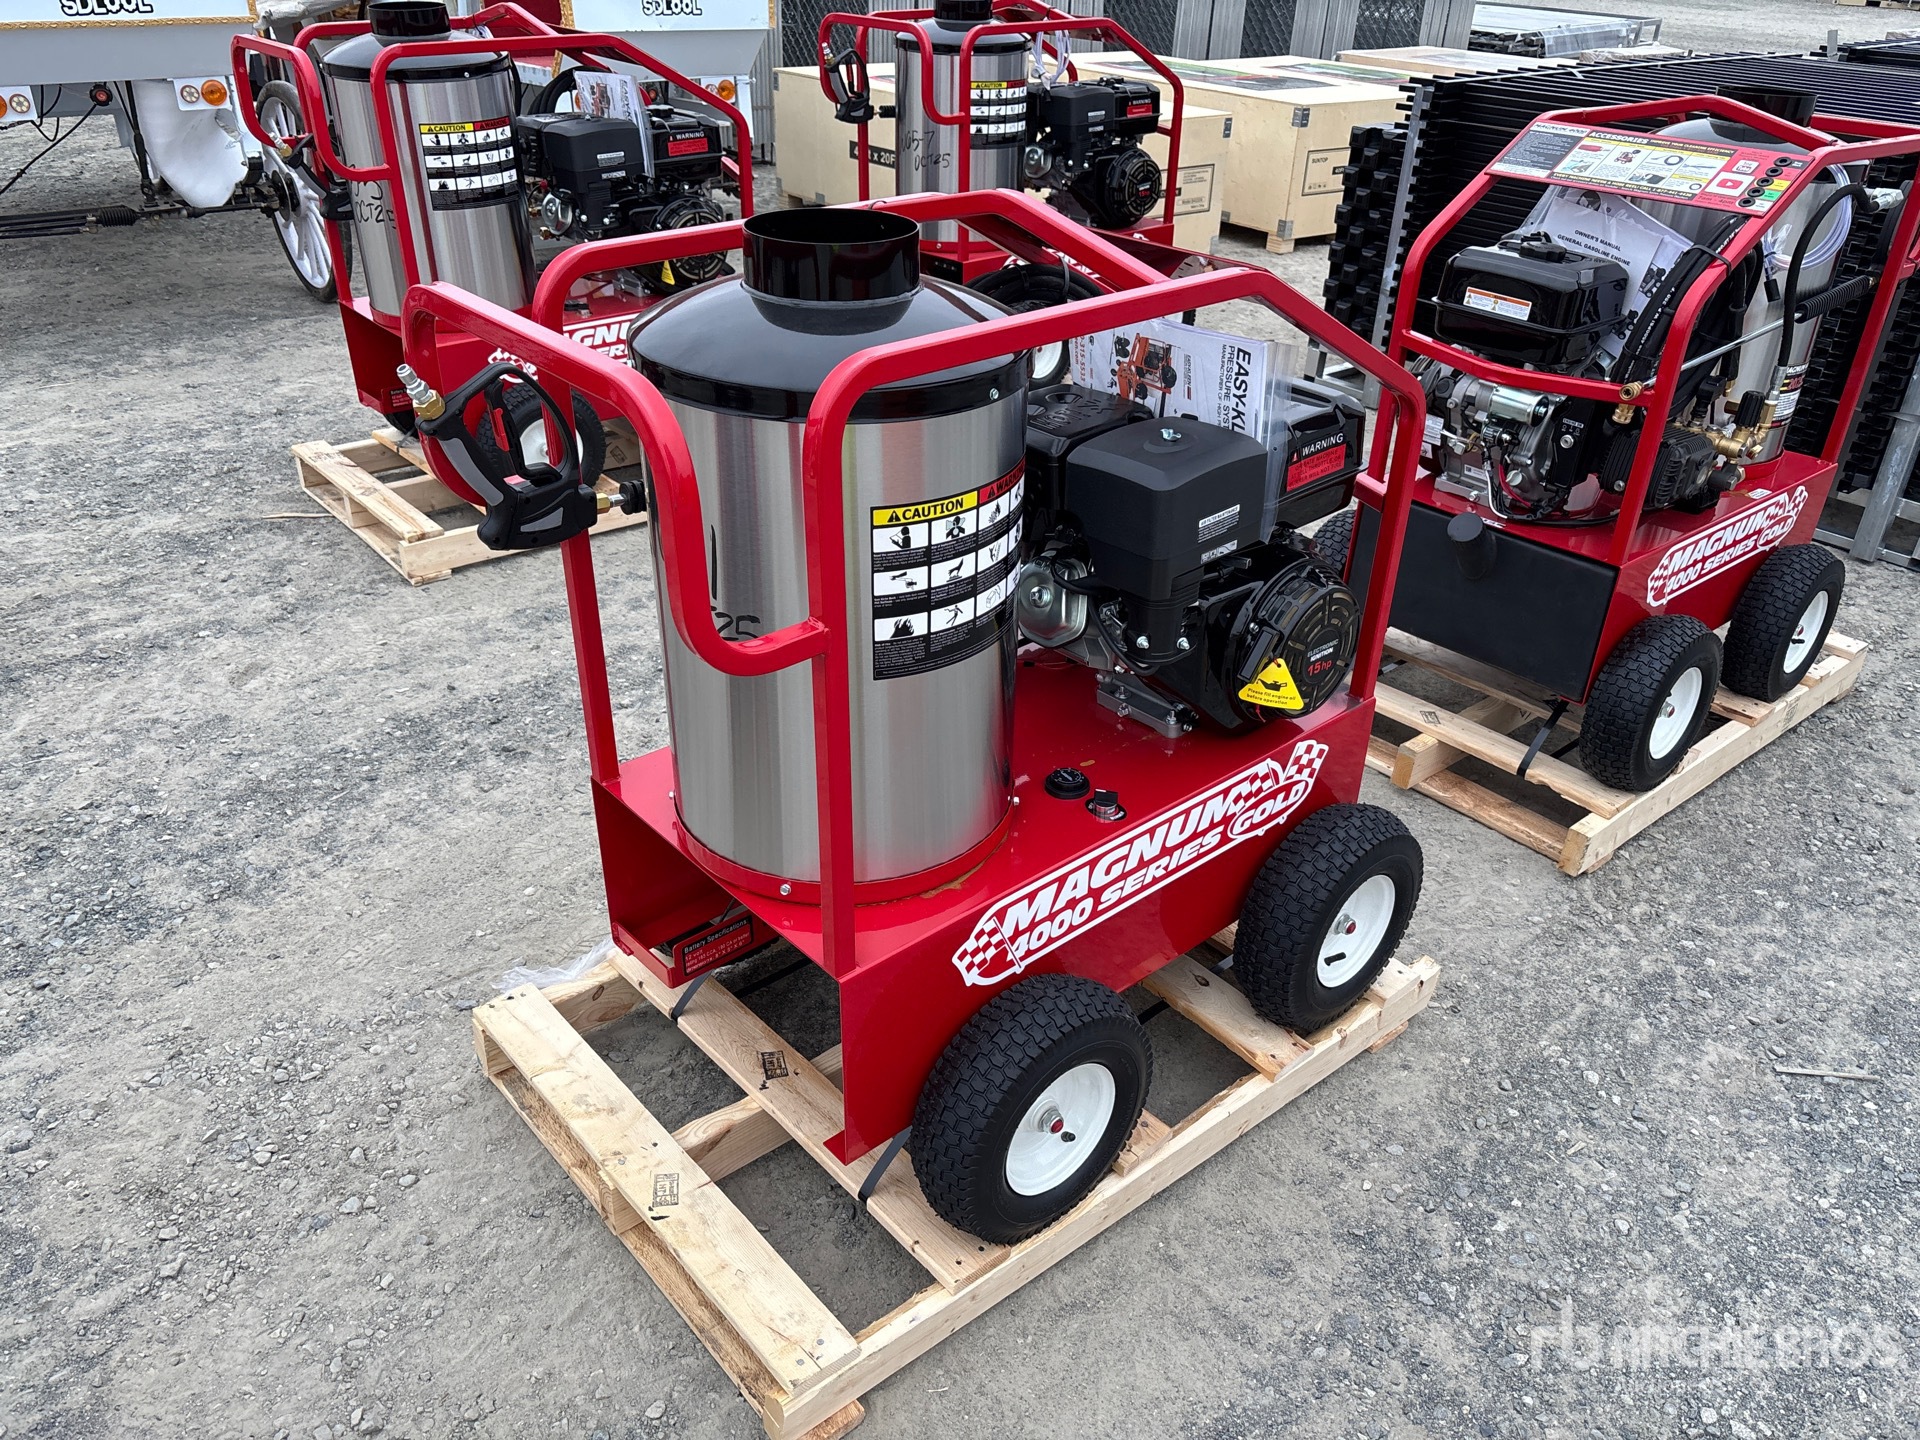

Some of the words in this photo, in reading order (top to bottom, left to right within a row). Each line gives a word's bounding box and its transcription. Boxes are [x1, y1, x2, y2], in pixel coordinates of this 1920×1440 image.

[433, 124, 466, 132] CAUTION
[676, 131, 704, 140] WARNING
[1589, 131, 1650, 145] ACCESSORIES
[1557, 234, 1582, 247] GENERAL
[1583, 243, 1610, 258] GASOLINE
[1610, 254, 1631, 266] ENGINE
[1574, 229, 1598, 242] OWNER'S
[1600, 238, 1621, 252] MANUAL
[1217, 344, 1227, 392] MANUFACTURER
[1223, 345, 1236, 402] PRESSURE
[1217, 392, 1223, 401] OF
[1302, 433, 1344, 456] WARNING
[1320, 465, 1330, 473] NOT
[902, 497, 964, 521] CAUTION
[1667, 508, 1772, 575] MAGNUM
[1759, 516, 1793, 544] GOLD
[1663, 562, 1702, 593] 4000
[1701, 537, 1758, 574] SERIES
[1307, 638, 1339, 657] ELECTRONIC
[1310, 647, 1334, 662] IGNITION
[1246, 693, 1262, 701] before
[1247, 687, 1264, 696] Please
[1271, 693, 1289, 701] engine
[1235, 782, 1308, 832] GOLD
[1001, 783, 1246, 935] MAGNUM
[1006, 896, 1095, 960] 4000
[1097, 824, 1225, 911] SERIES
[684, 941, 706, 954] Battery
[706, 920, 747, 943] Specifications
